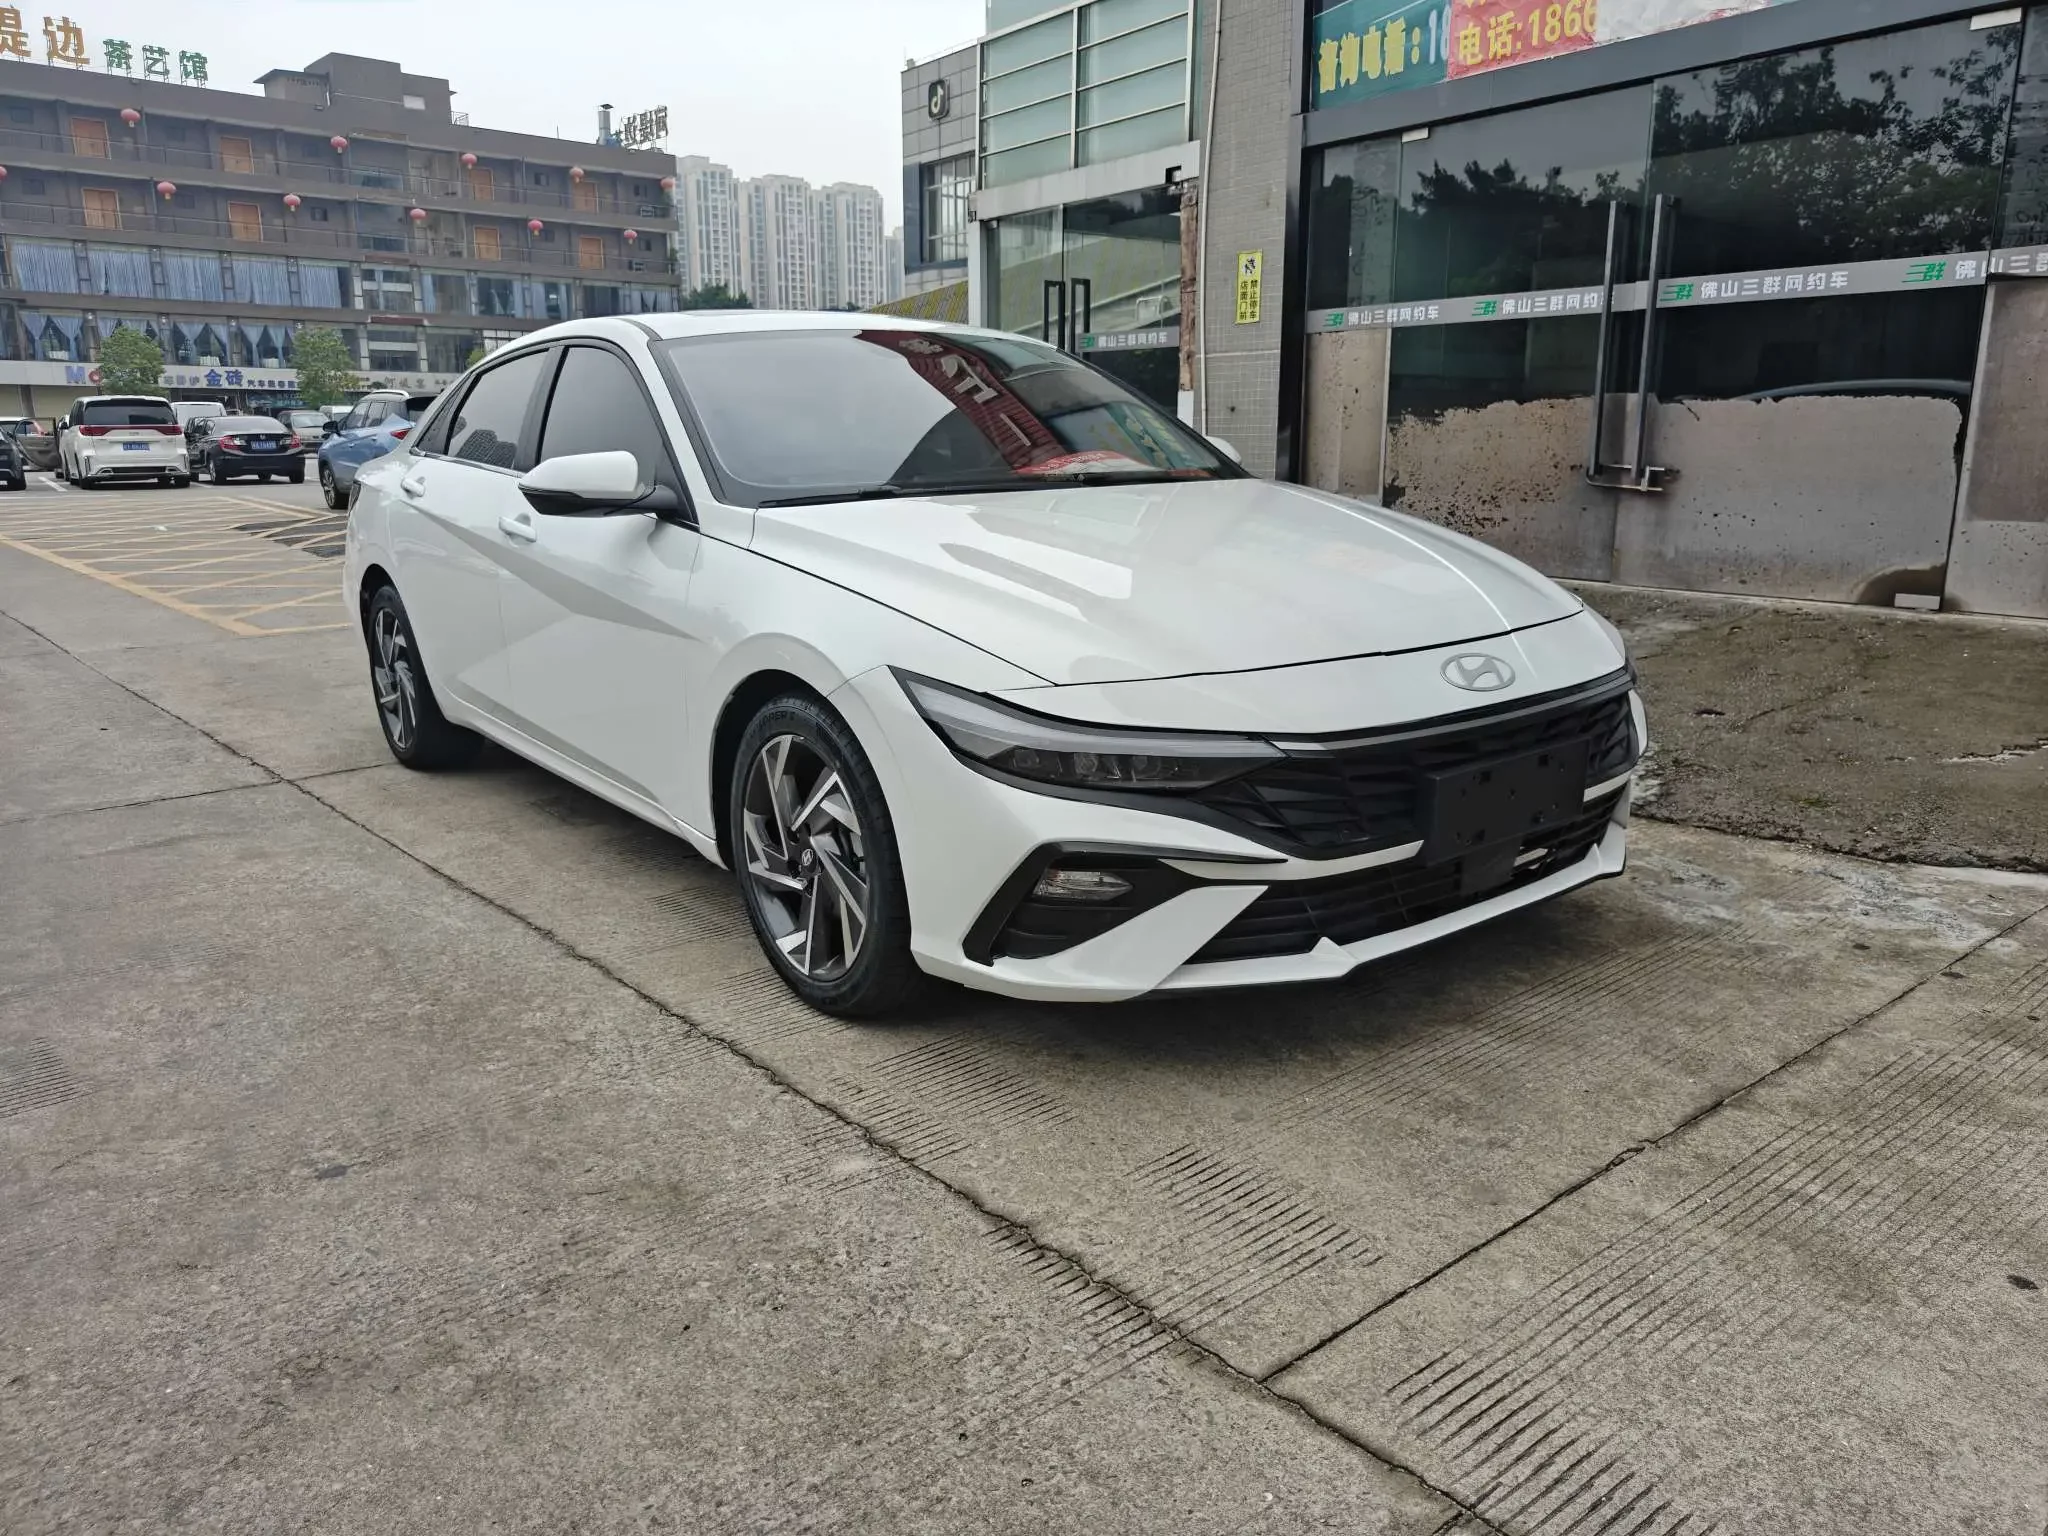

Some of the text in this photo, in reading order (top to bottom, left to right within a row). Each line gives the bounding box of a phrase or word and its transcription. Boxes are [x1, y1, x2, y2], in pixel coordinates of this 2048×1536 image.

[103, 39, 209, 82] 茶艺馆
[1700, 271, 1849, 299] 佛山三群网约车
[1502, 291, 1615, 315] 佛山三群网约
[1348, 305, 1440, 326] 佛山三群网约车
[204, 368, 243, 388] 金砖
